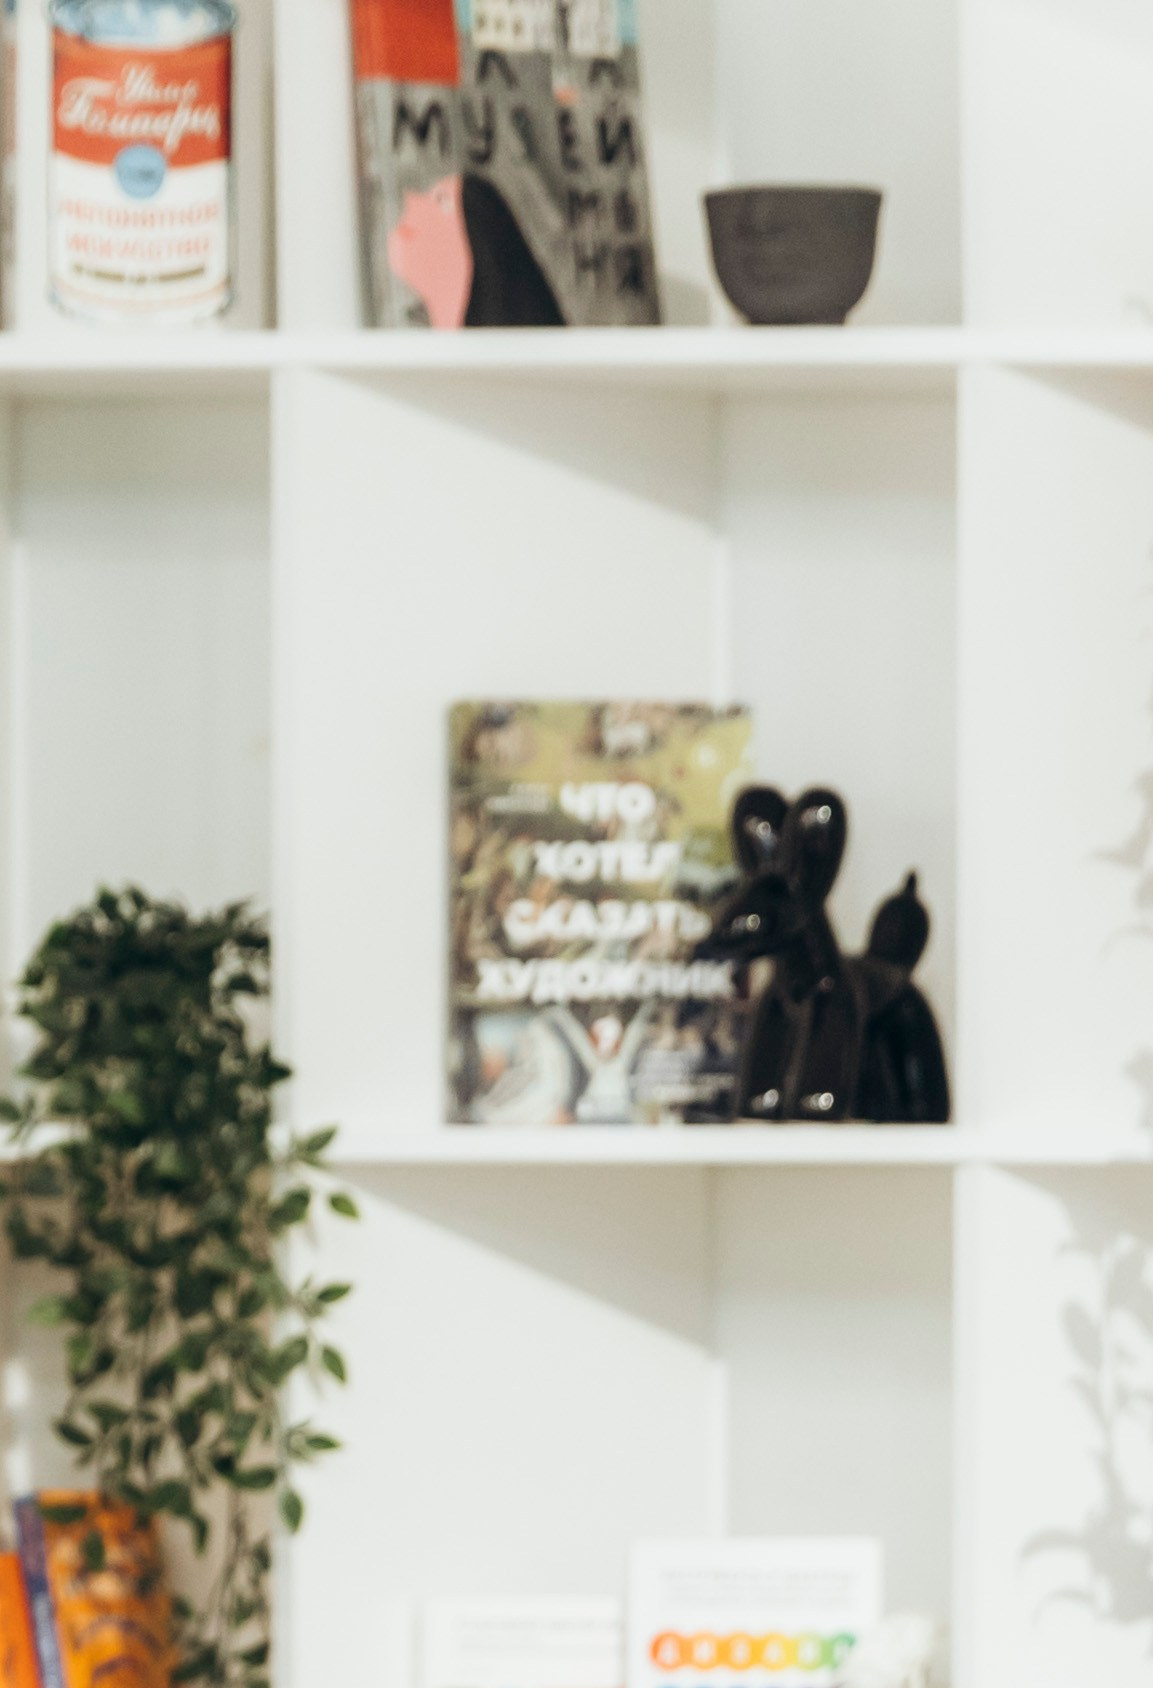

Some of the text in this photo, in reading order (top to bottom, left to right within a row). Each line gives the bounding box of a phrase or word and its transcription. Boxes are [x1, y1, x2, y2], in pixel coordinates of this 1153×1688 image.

[559, 781, 656, 823] ЧТО
[532, 841, 681, 884] ХОТЕЛ
[503, 901, 714, 947] СКАЗАТЬ
